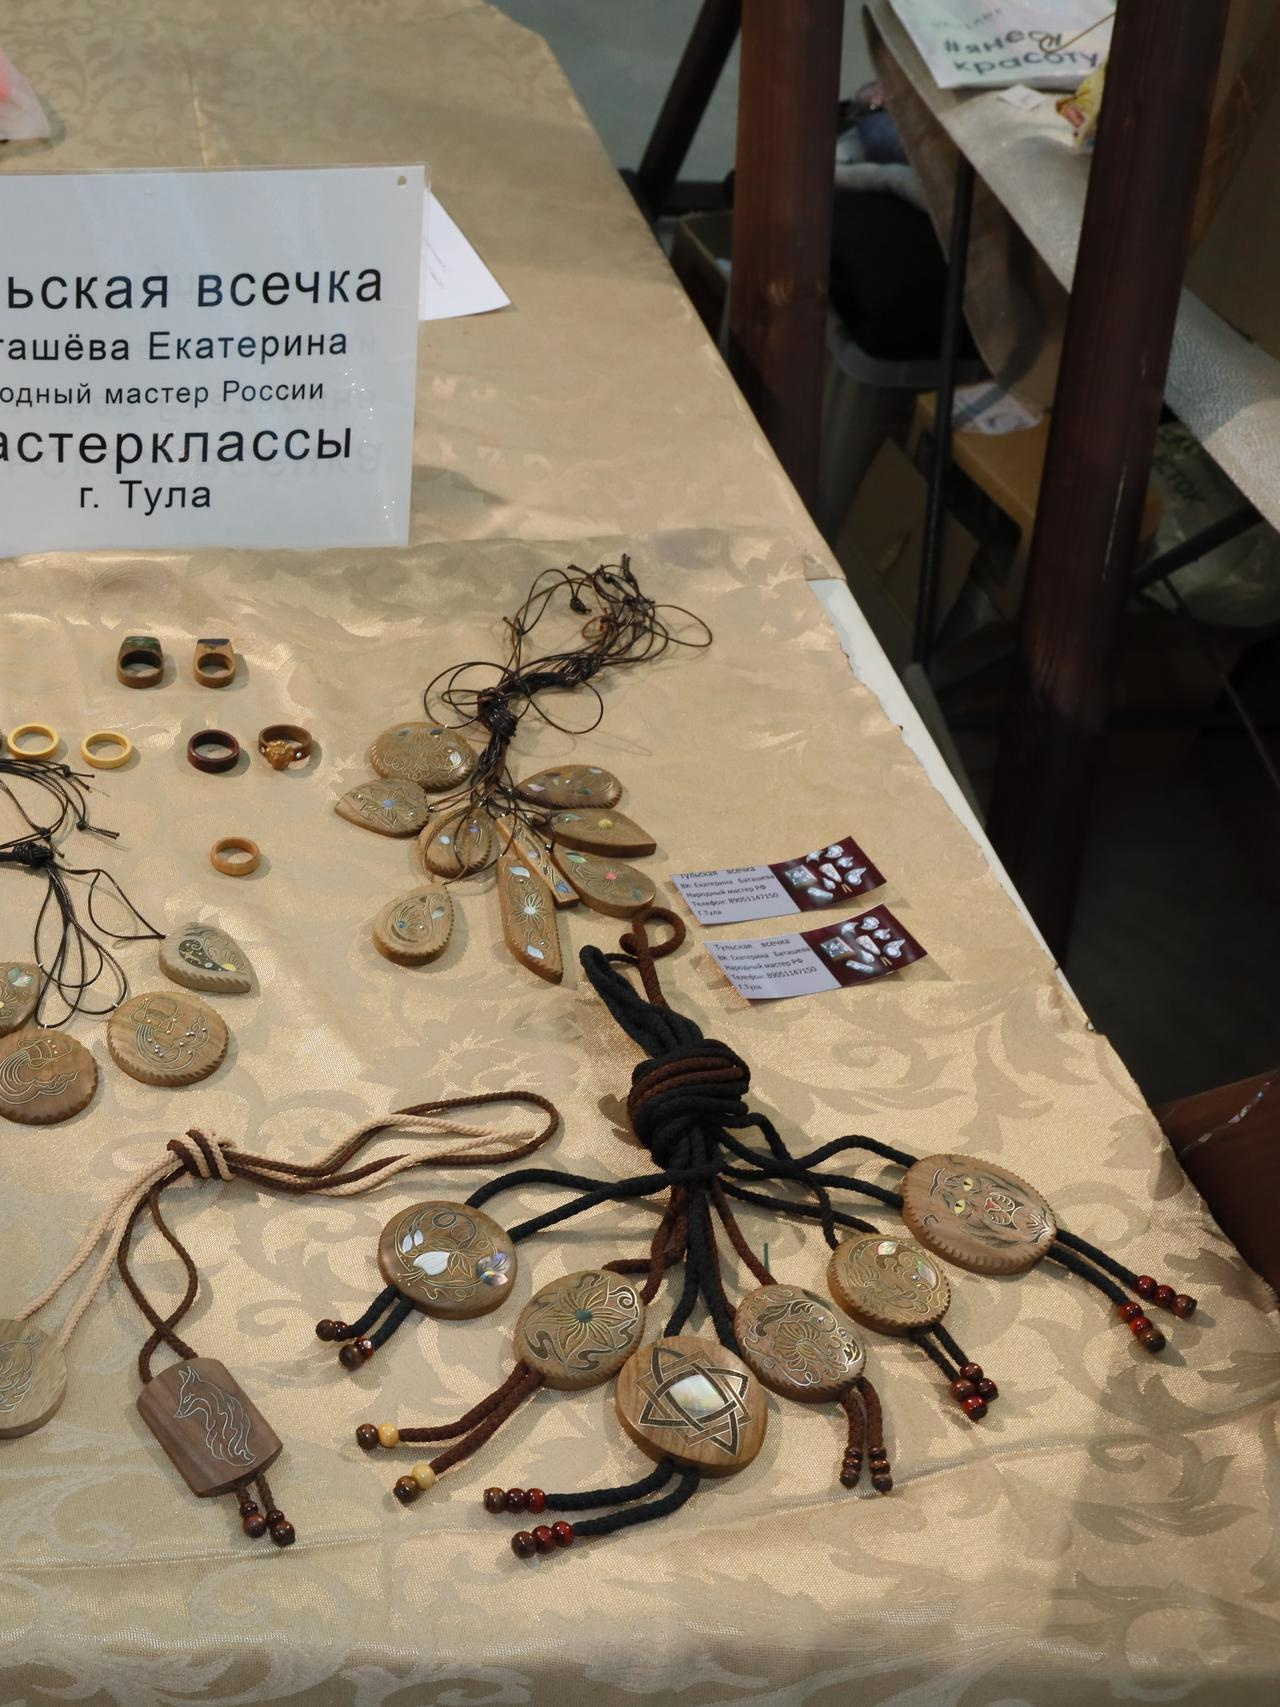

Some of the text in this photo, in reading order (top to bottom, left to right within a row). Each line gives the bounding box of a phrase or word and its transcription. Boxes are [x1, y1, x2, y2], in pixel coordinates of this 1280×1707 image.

[954, 51, 1099, 75] красоту
[197, 267, 383, 307] всечка
[149, 331, 348, 364] Екатерина
[105, 384, 209, 408] мастер
[223, 380, 324, 402] России
[80, 480, 212, 516] г. Тула
